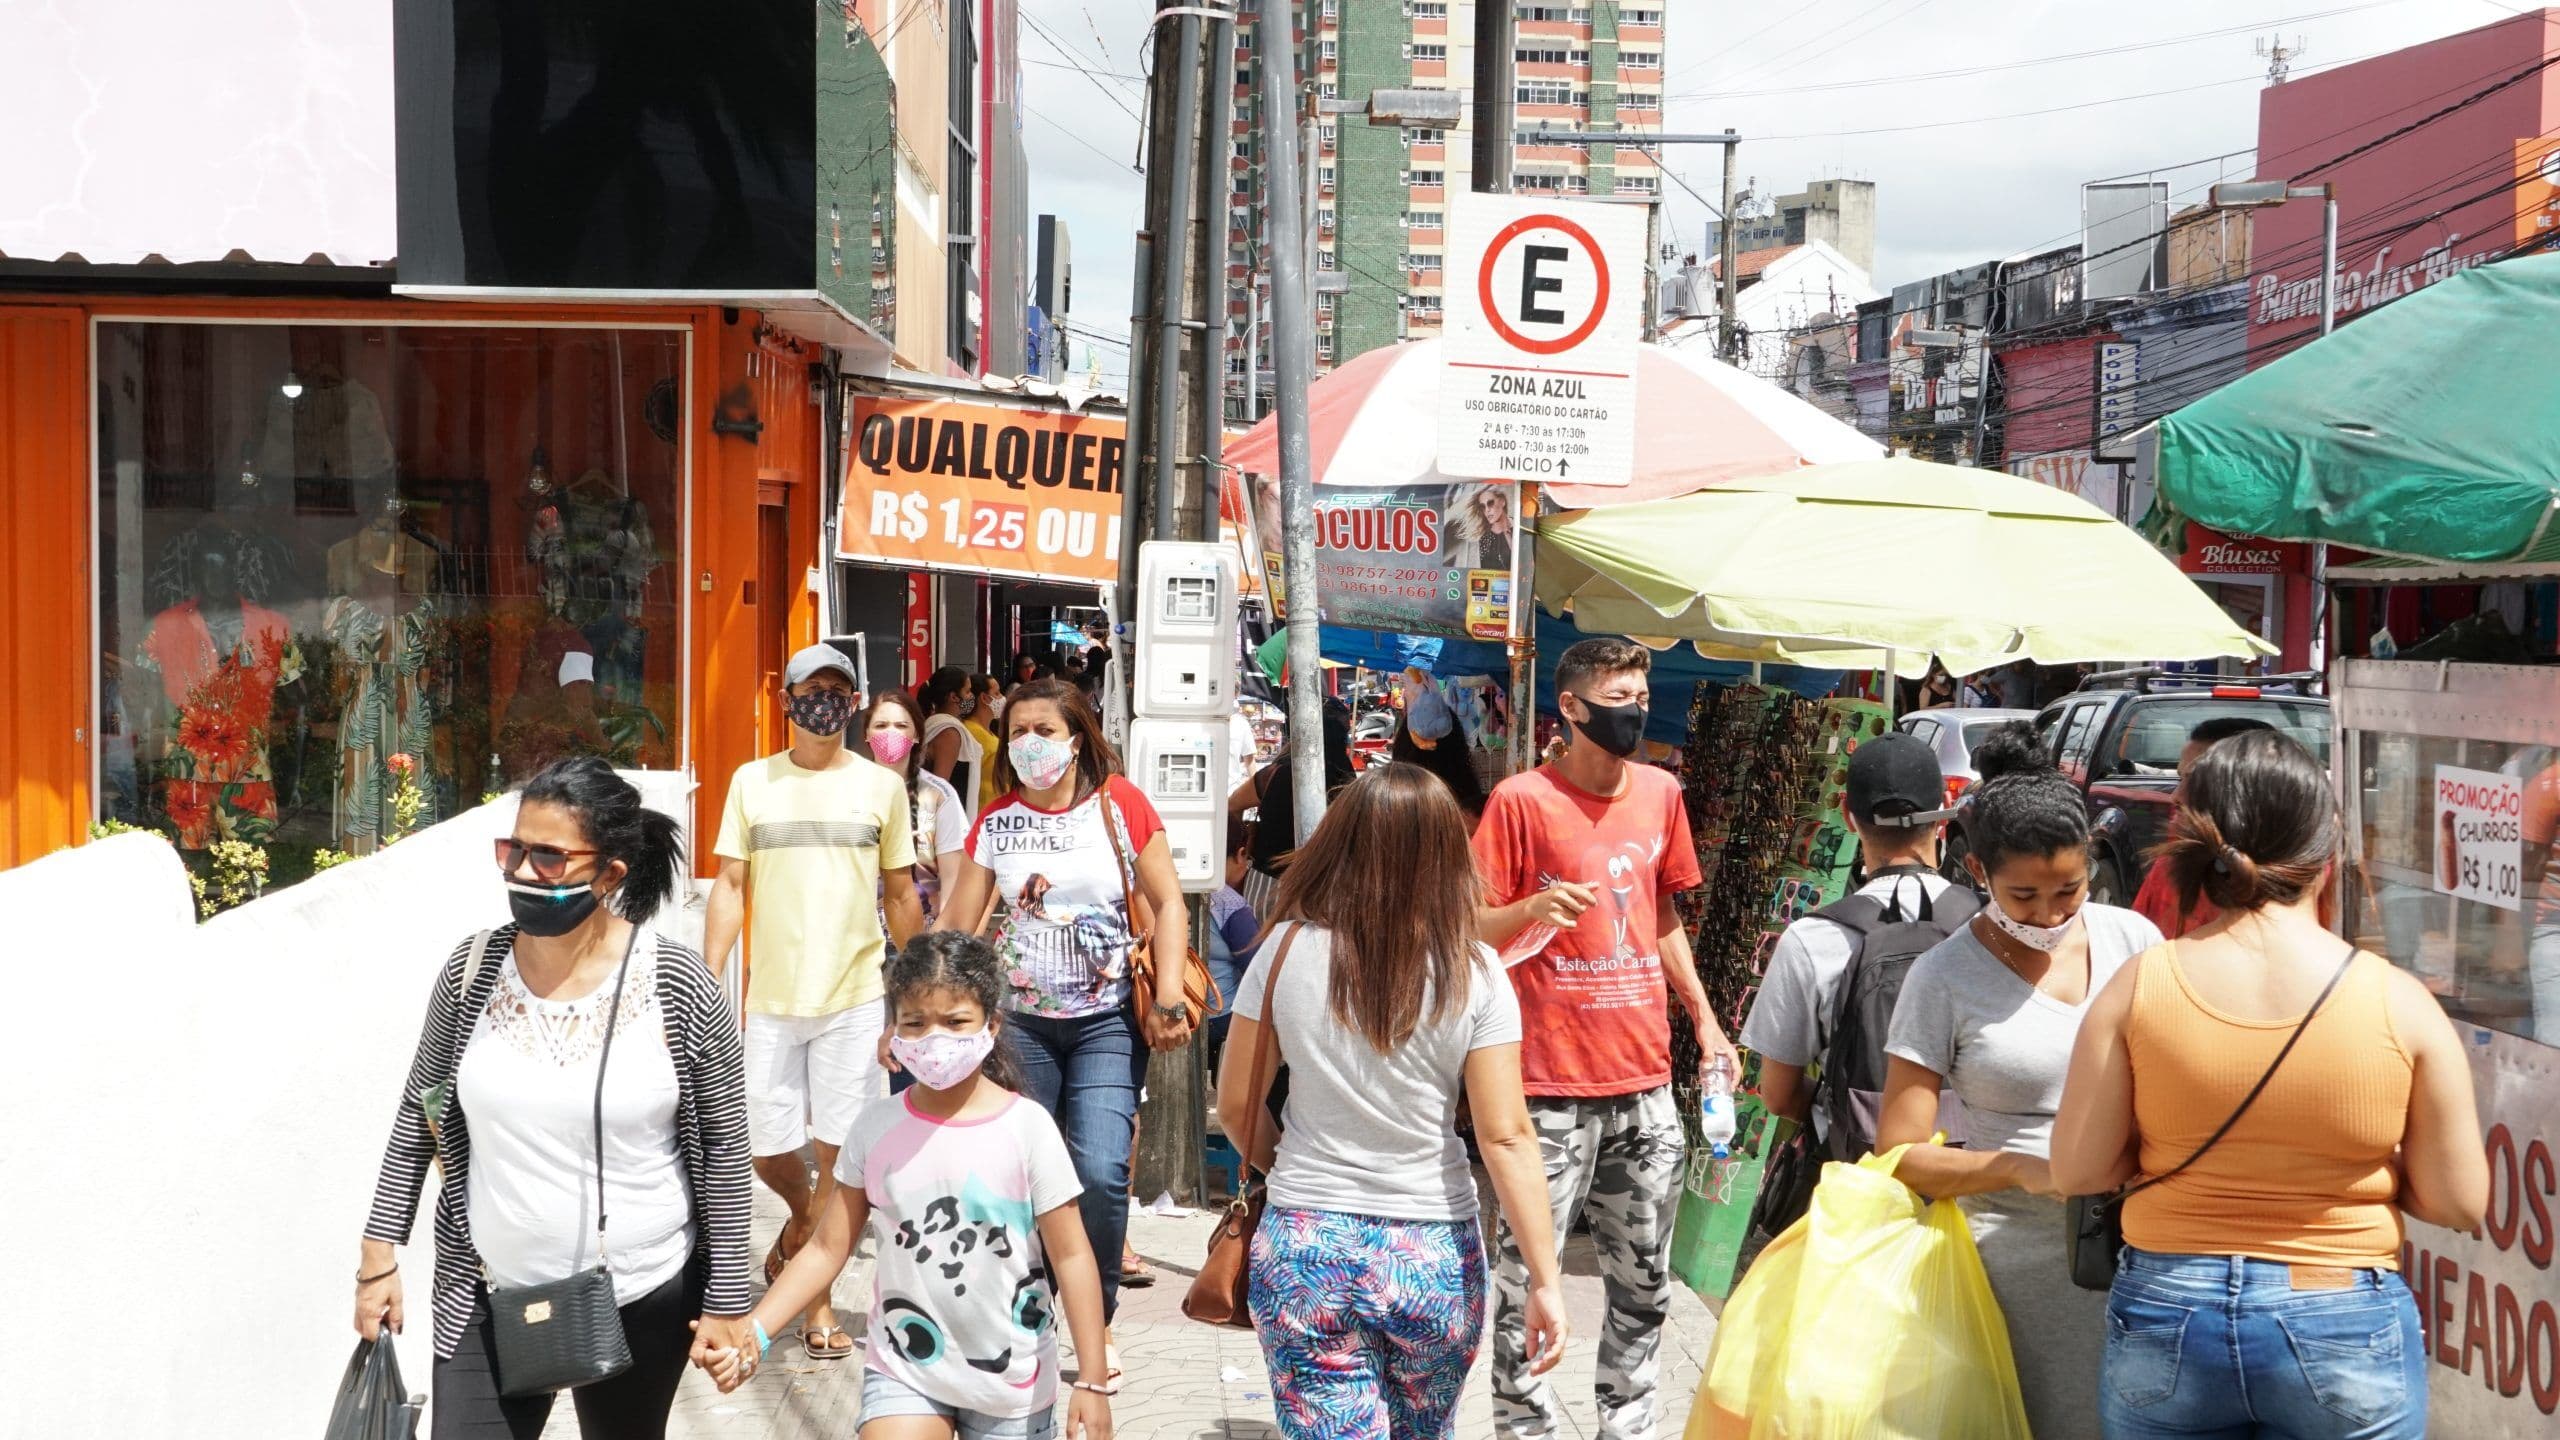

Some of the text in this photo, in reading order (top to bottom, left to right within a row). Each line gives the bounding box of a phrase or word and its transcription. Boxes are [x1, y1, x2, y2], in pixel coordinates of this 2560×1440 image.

[1520, 244, 1568, 325] E
[1489, 375, 1586, 399] ZONA AZUL
[2104, 348, 2121, 431] POUSADA
[1465, 399, 1484, 411] USO
[1554, 406, 1567, 418] DO
[1570, 407, 1608, 421] CARTÃO
[1495, 423, 1501, 434] A
[1521, 425, 1540, 436] 7:30
[1556, 427, 1586, 439] 17:30h
[859, 413, 1126, 495] QUALQUER
[1525, 441, 1544, 453] 7:30
[1560, 443, 1589, 455] 12:00h
[1500, 454, 1552, 473] INÍCIO
[870, 489, 929, 543] R$
[939, 498, 1026, 551] 1,25
[1036, 507, 1097, 558] OU
[1313, 499, 1438, 555] ÓCULOS
[2200, 542, 2282, 564] Blusas
[1336, 565, 1439, 582] 98757-2070
[2207, 565, 2281, 573] COLLECTION
[1340, 580, 1437, 599] 98619-1661
[2440, 779, 2520, 817] PROMOÇÃO
[988, 833, 1075, 852] UMMER
[2459, 821, 2519, 843] CHURROS
[2463, 854, 2517, 899] R$ 1,00
[1555, 955, 1618, 975] Estação
[2452, 1122, 2556, 1270] OS
